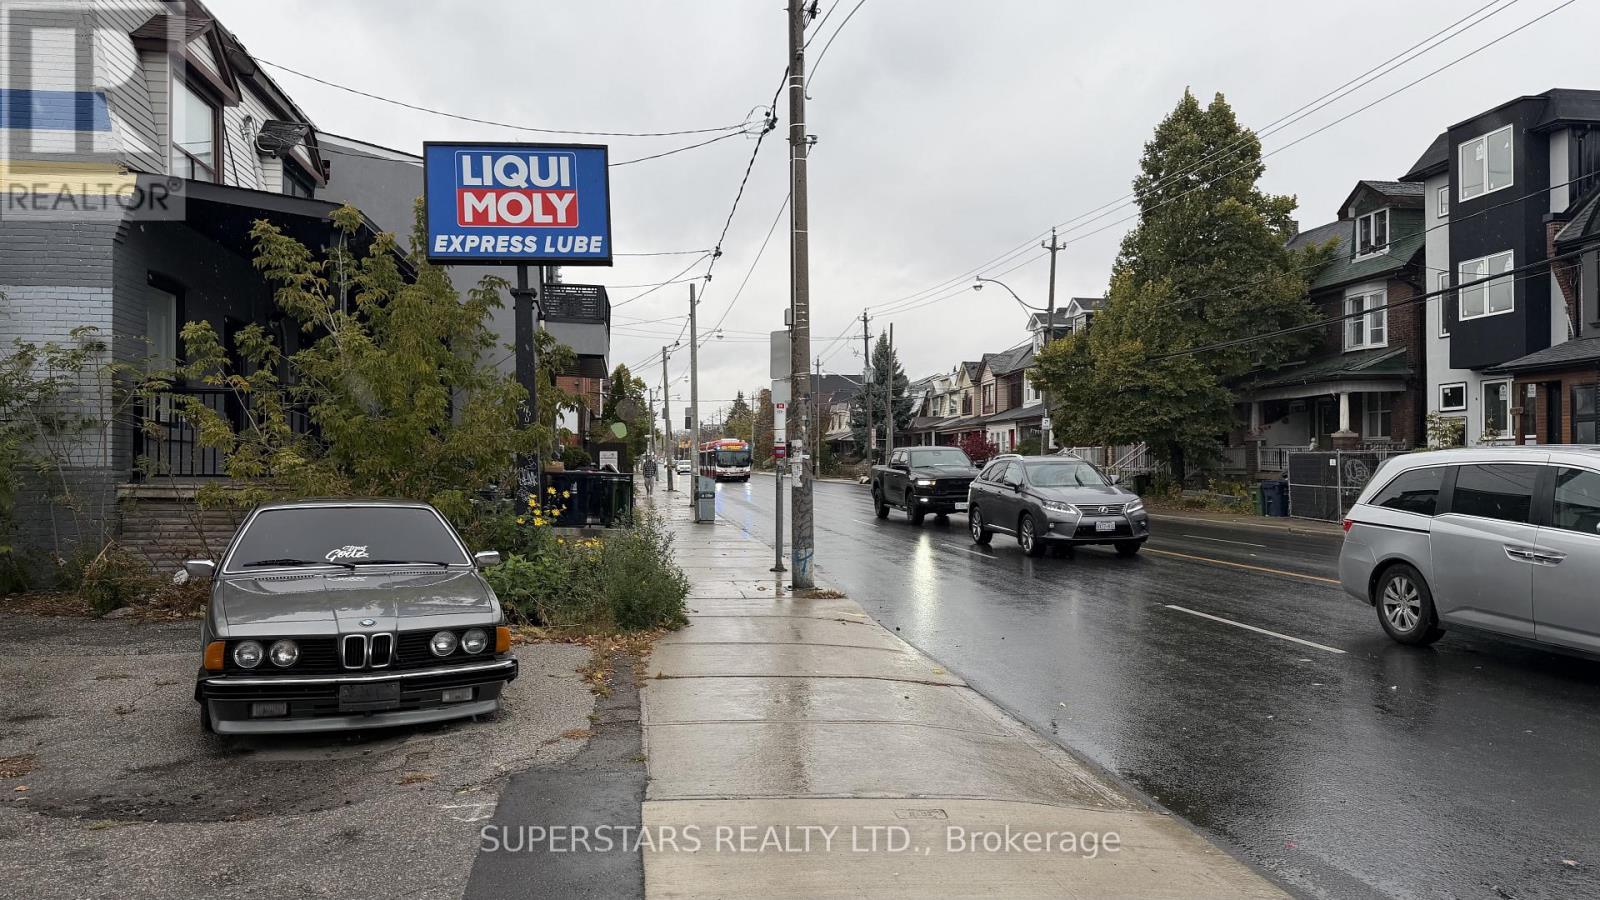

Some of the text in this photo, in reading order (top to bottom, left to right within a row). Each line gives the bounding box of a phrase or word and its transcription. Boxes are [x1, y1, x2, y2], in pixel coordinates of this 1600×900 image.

[462, 155, 570, 188] LIQUI
[463, 192, 575, 224] MOLY
[434, 234, 603, 253] EXPRESS LUBE
